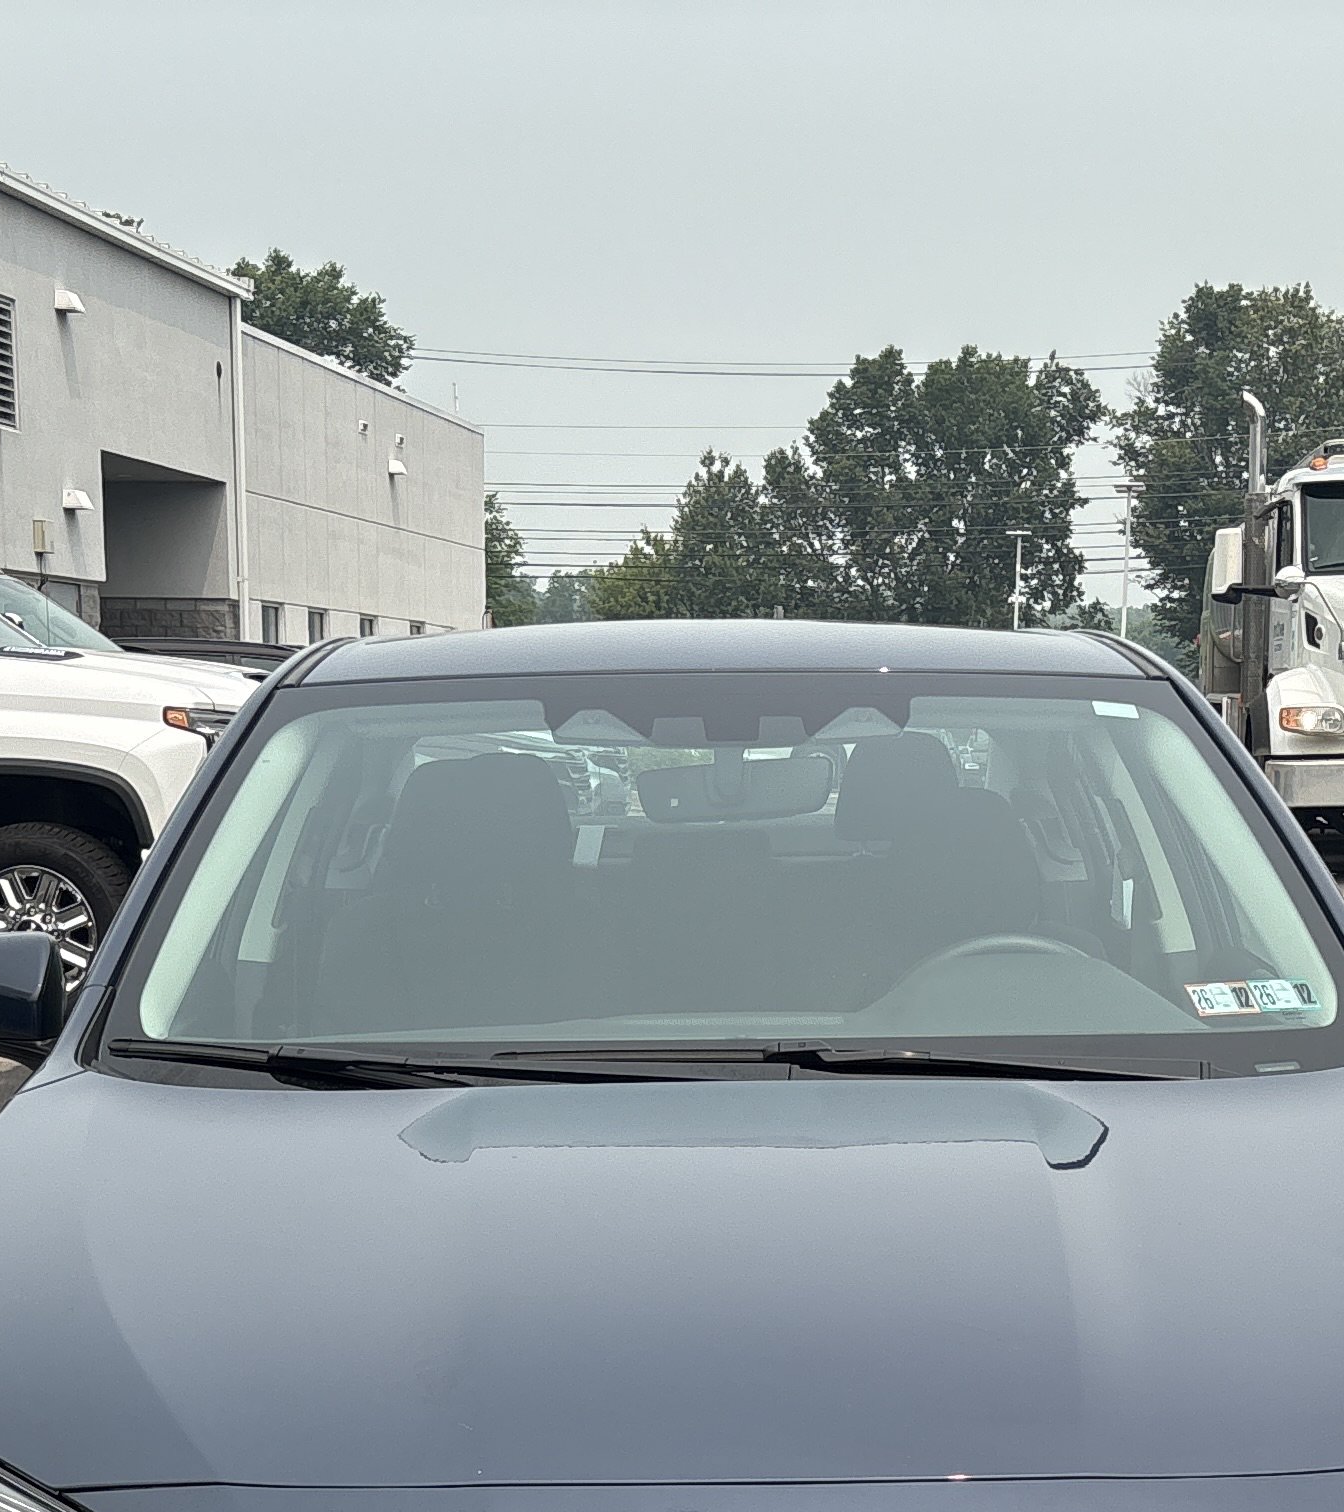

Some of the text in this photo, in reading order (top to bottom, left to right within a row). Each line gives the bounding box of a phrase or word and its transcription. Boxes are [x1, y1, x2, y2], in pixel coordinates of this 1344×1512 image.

[1192, 986, 1255, 1011] 26 12
[1254, 983, 1318, 1006] 26 12
